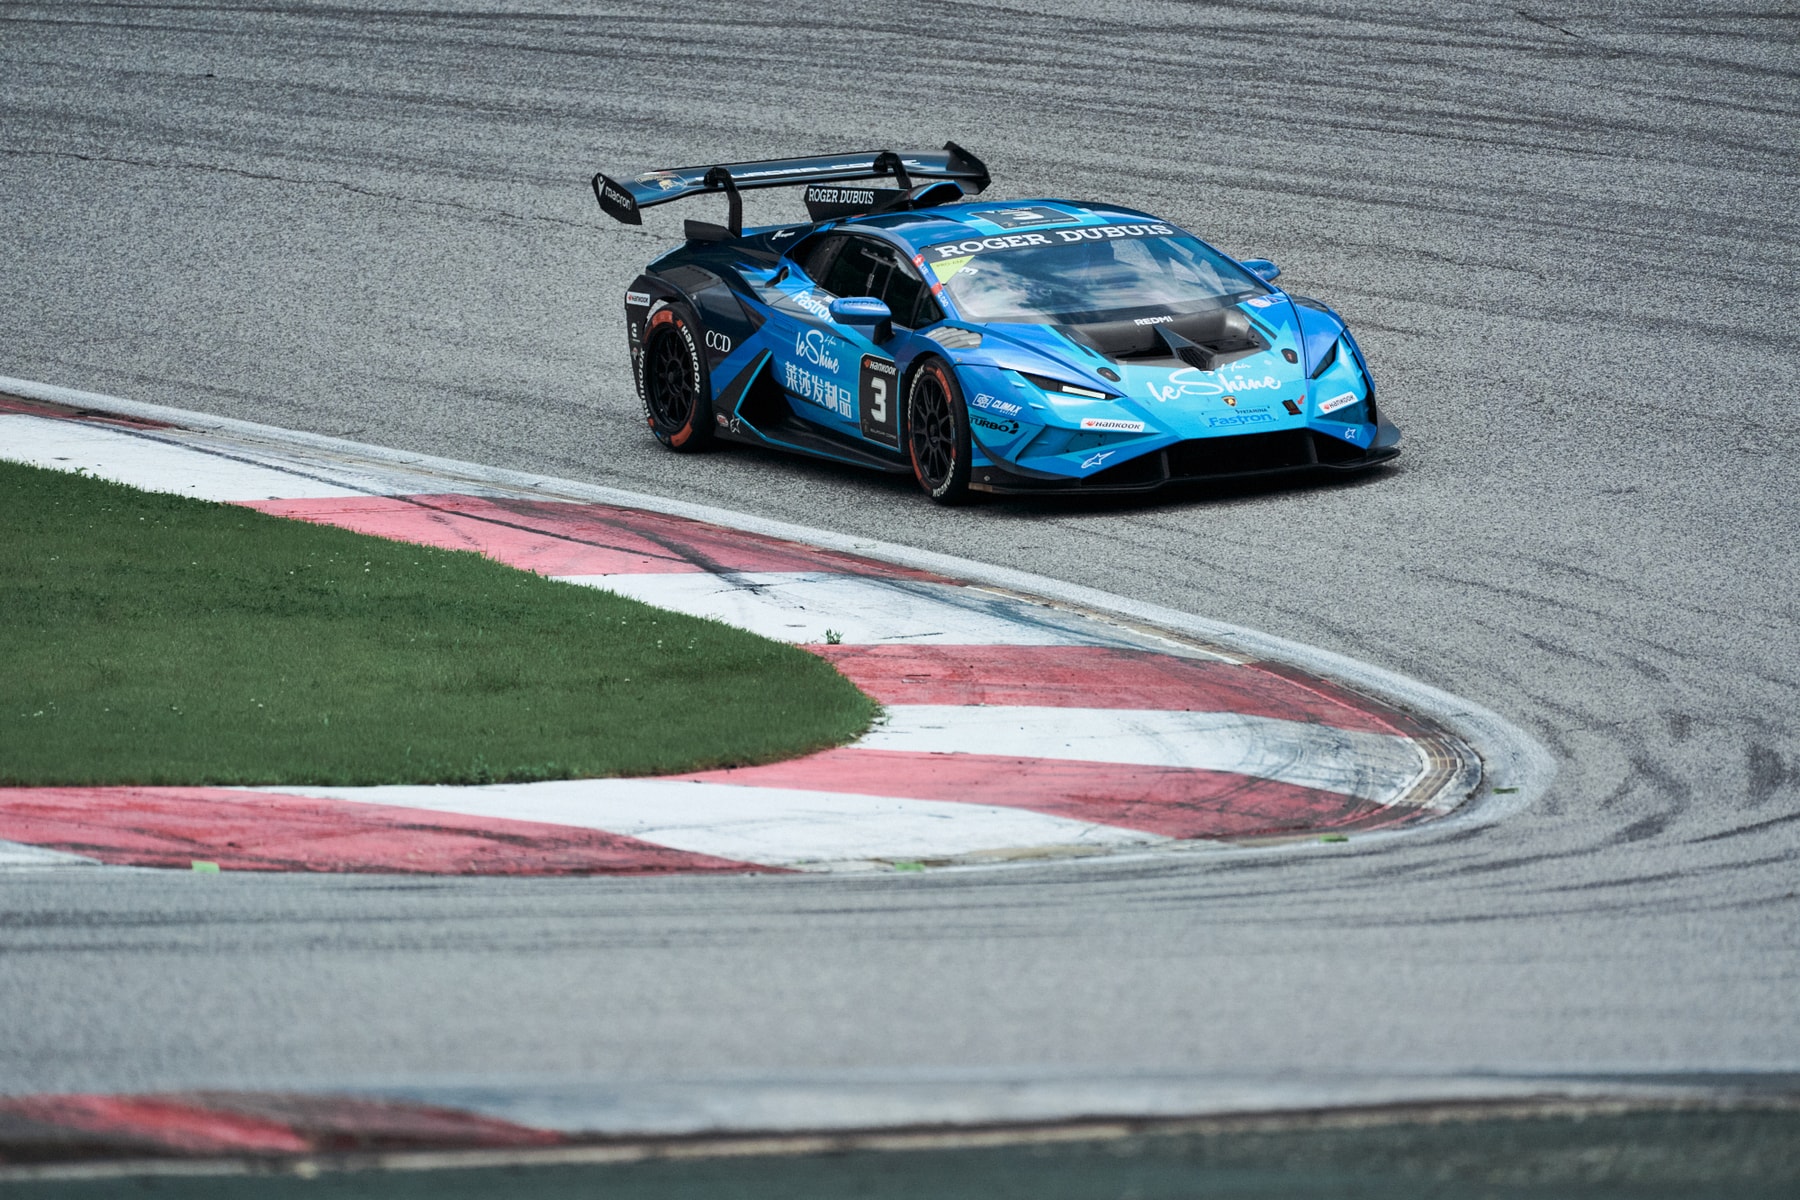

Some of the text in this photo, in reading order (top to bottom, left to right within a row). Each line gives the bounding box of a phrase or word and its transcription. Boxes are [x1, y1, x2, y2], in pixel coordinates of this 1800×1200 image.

[604, 186, 632, 211] macron
[808, 188, 874, 205] ROGER DUBUIS
[935, 225, 1174, 258] ROGER DUBUIS
[1134, 315, 1174, 327] REDMI
[705, 330, 731, 352] CCD
[784, 360, 852, 419] 莱莎发制品
[870, 376, 887, 423] 3
[991, 399, 1023, 414] CLIMAX
[969, 415, 1009, 433] TURBO
[1208, 413, 1273, 427] Fastron
